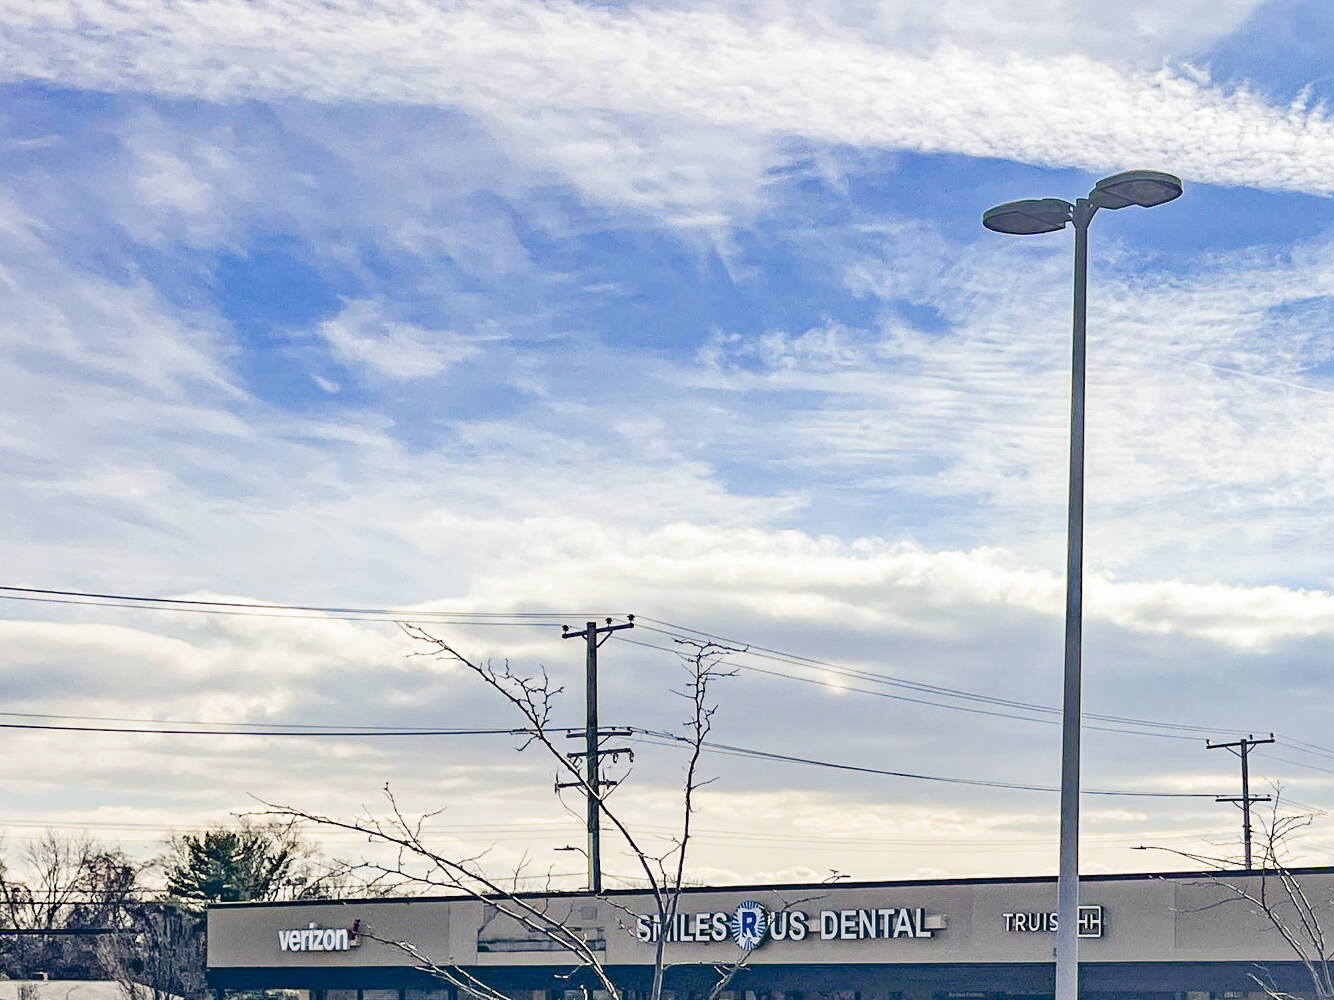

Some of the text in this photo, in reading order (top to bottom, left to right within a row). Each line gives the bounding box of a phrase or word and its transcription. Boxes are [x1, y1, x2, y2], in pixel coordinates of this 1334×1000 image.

[278, 921, 348, 951] verizon
[637, 912, 728, 942] SMILES
[770, 911, 807, 941] US
[819, 908, 933, 940] DENTAL
[1002, 912, 1059, 932] TRUIS
